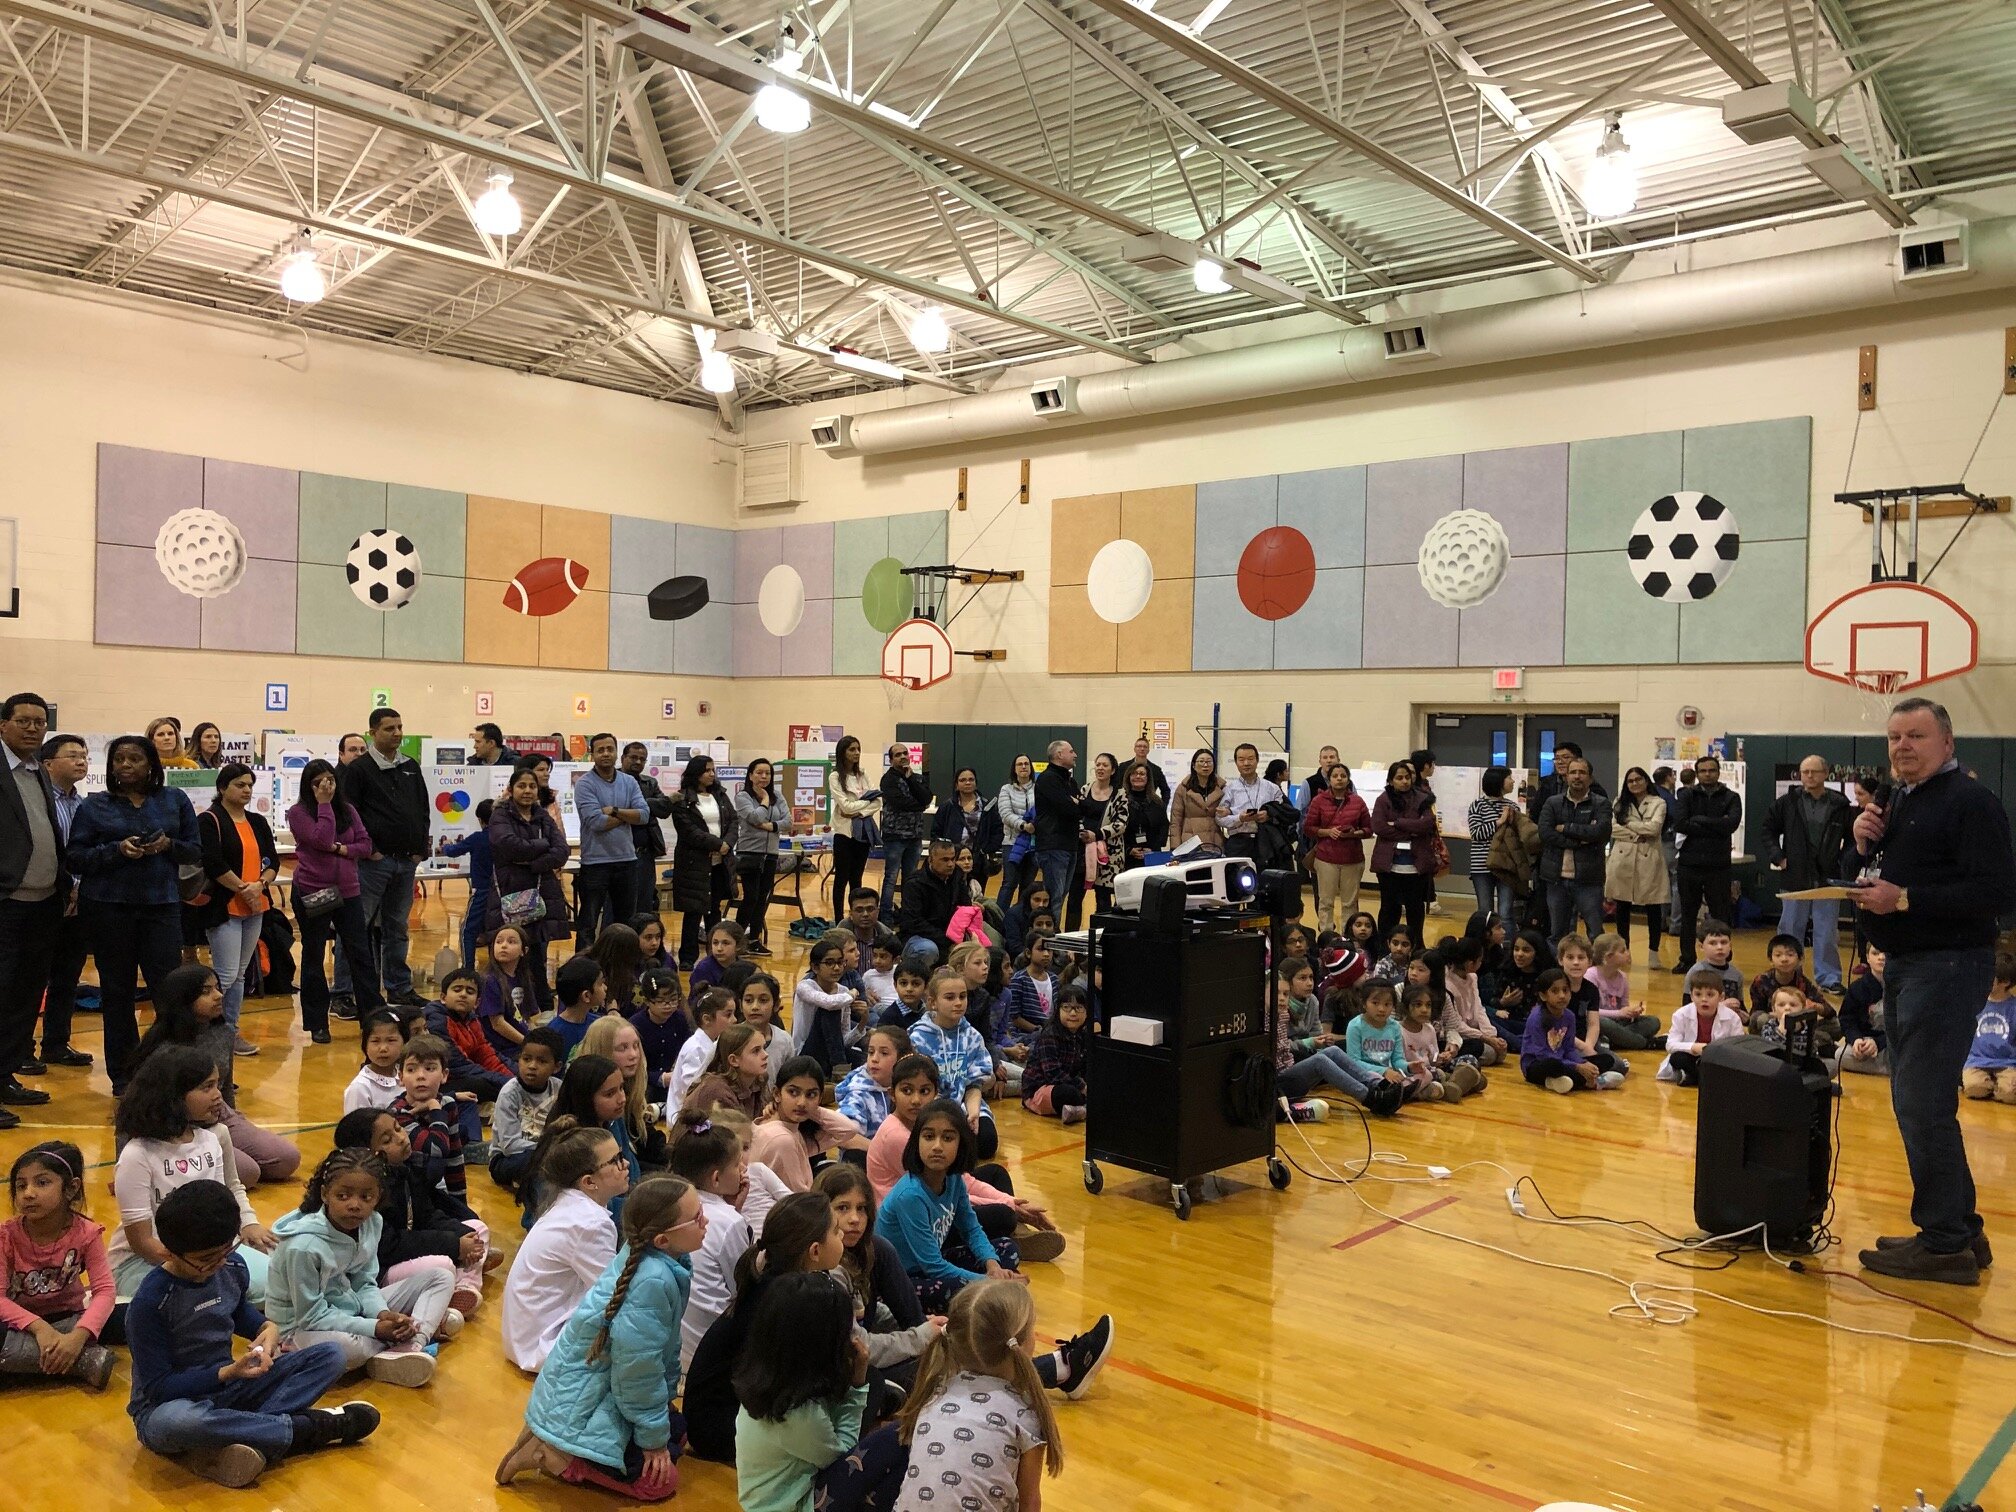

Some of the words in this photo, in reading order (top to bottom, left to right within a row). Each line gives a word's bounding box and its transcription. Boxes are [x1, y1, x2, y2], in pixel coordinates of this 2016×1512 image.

[272, 690, 282, 704] 1
[376, 693, 387, 707] 2
[480, 697, 489, 710] 3
[576, 699, 587, 713] 4
[664, 703, 674, 716] 5
[439, 777, 465, 785] COLOR
